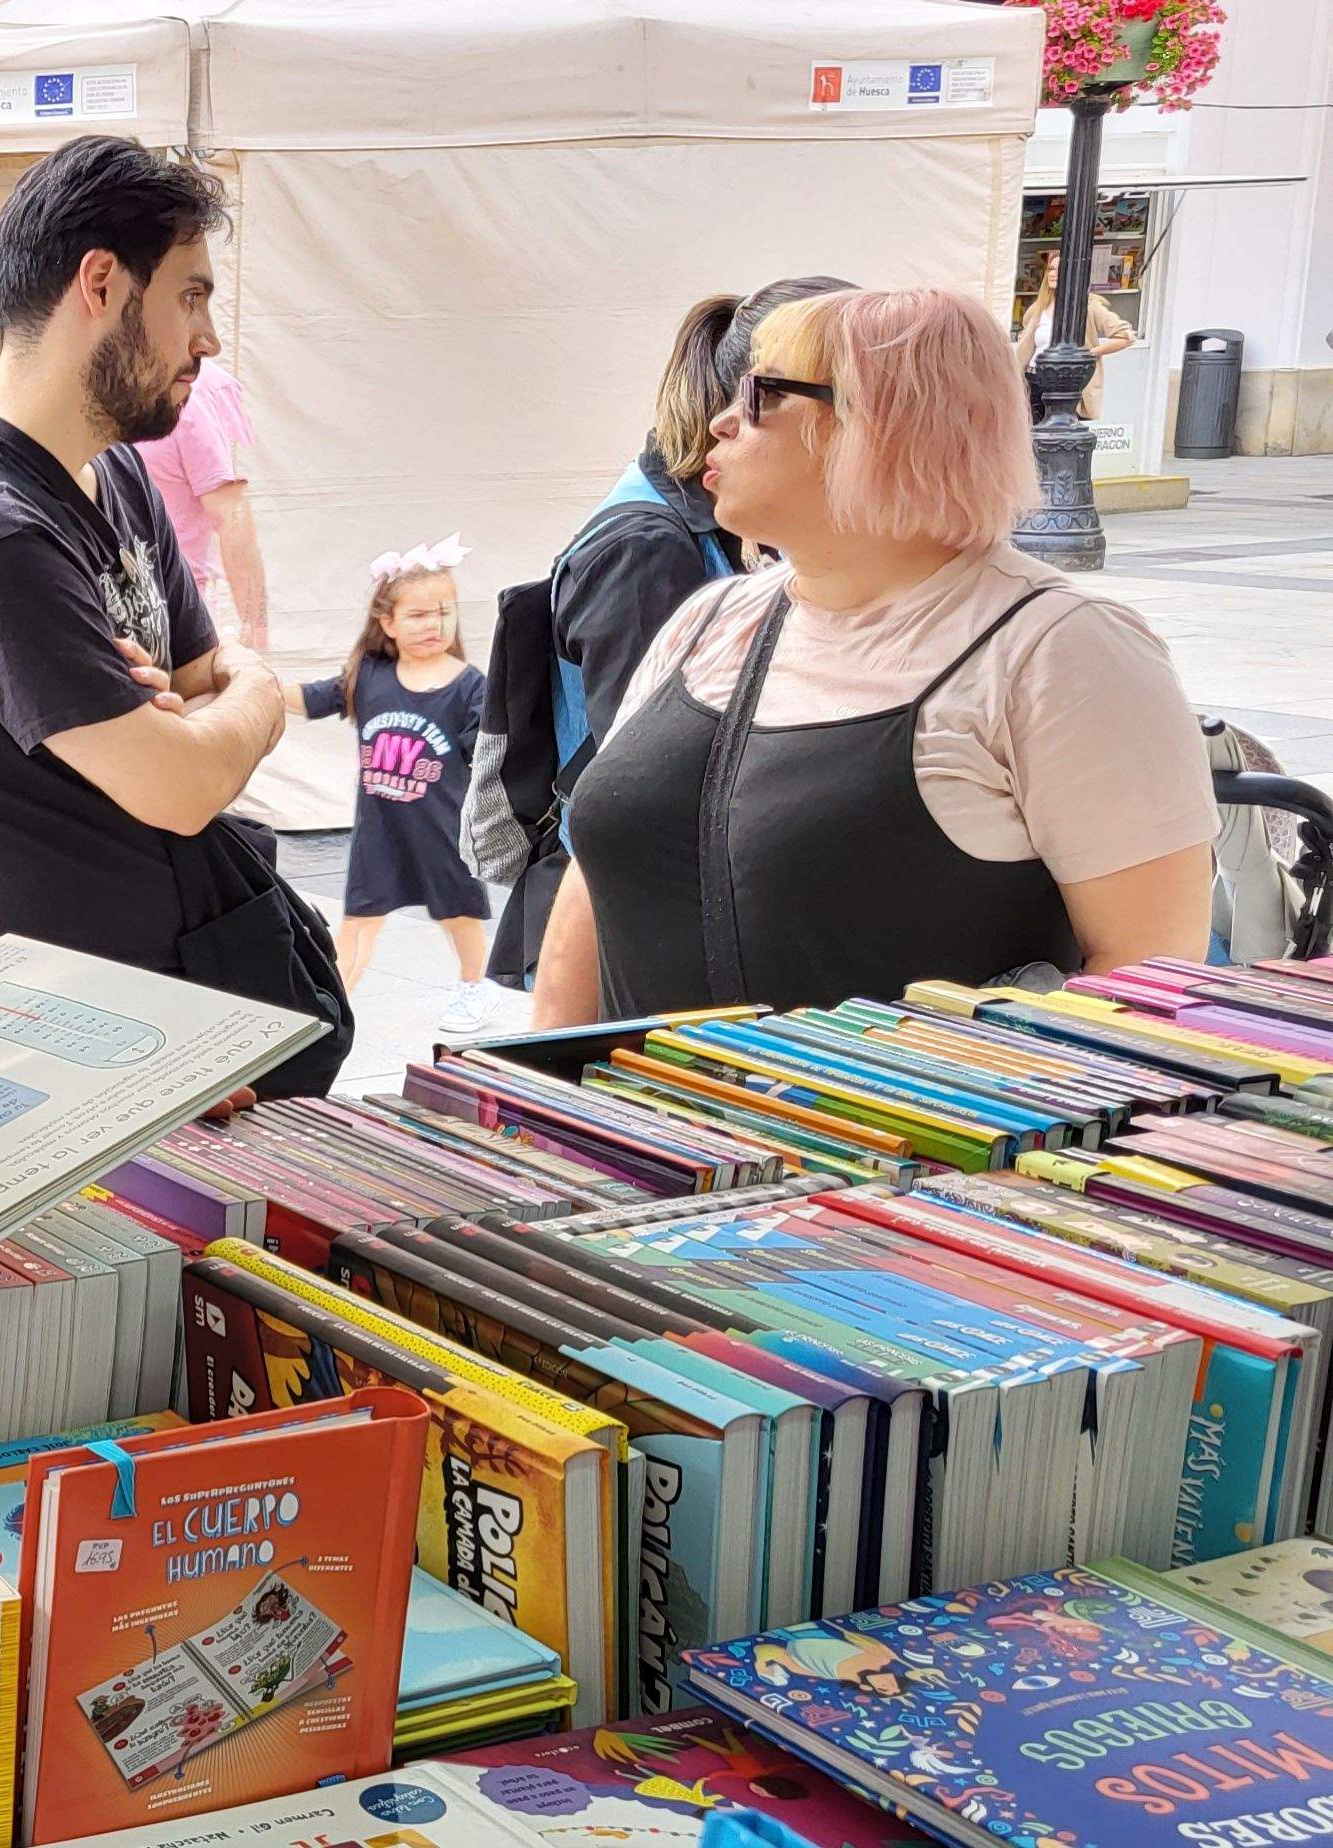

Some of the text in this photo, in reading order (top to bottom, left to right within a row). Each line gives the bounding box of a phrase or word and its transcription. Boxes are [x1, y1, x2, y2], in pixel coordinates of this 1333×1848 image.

[859, 87, 890, 97] Huesca
[373, 732, 426, 775] NY
[214, 1037, 254, 1066] qué
[159, 1065, 214, 1096] tiene
[113, 1096, 155, 1124] que
[80, 1123, 113, 1147] ver
[52, 1147, 79, 1161] la
[195, 1295, 205, 1327] sm
[228, 1370, 255, 1417] DA
[1187, 1414, 1227, 1481] MÁS
[152, 1491, 301, 1547] EL CUERPO
[449, 1455, 476, 1571] LA CAMADA
[166, 1539, 275, 1585] HUMANO
[1019, 1699, 1253, 1771] GRIEGOS
[1094, 1730, 1333, 1816] MITOS
[250, 1820, 273, 1835] Gil
[274, 1806, 336, 1826] Carmen
